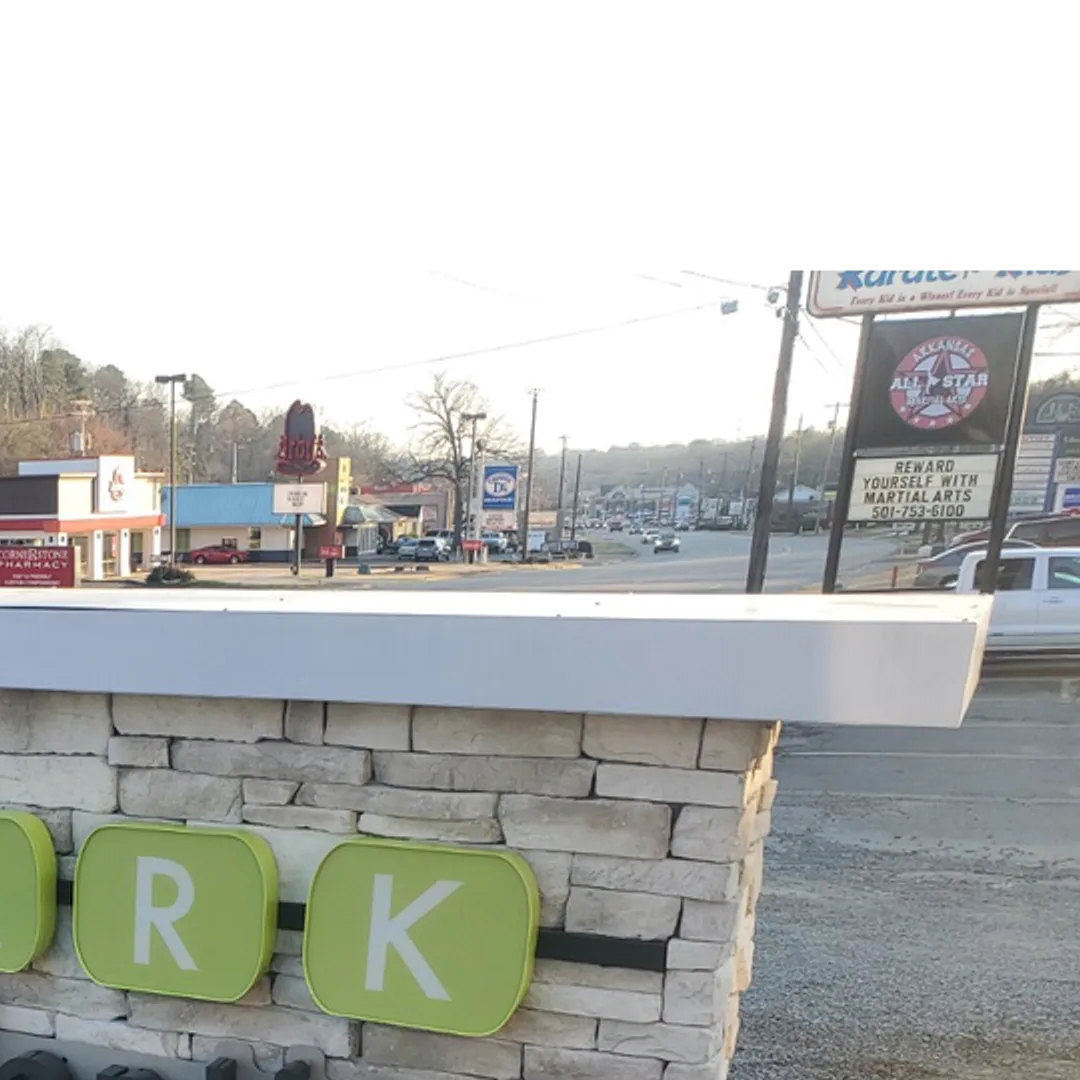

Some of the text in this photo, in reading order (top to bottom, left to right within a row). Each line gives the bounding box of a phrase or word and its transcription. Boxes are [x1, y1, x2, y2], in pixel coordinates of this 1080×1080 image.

[889, 372, 989, 391] ALL STAR
[894, 459, 955, 473] REWARD
[863, 474, 979, 490] YOURSELF WITH
[863, 489, 973, 504] MARTIAL ARTS
[872, 504, 966, 519] 501-753-6100
